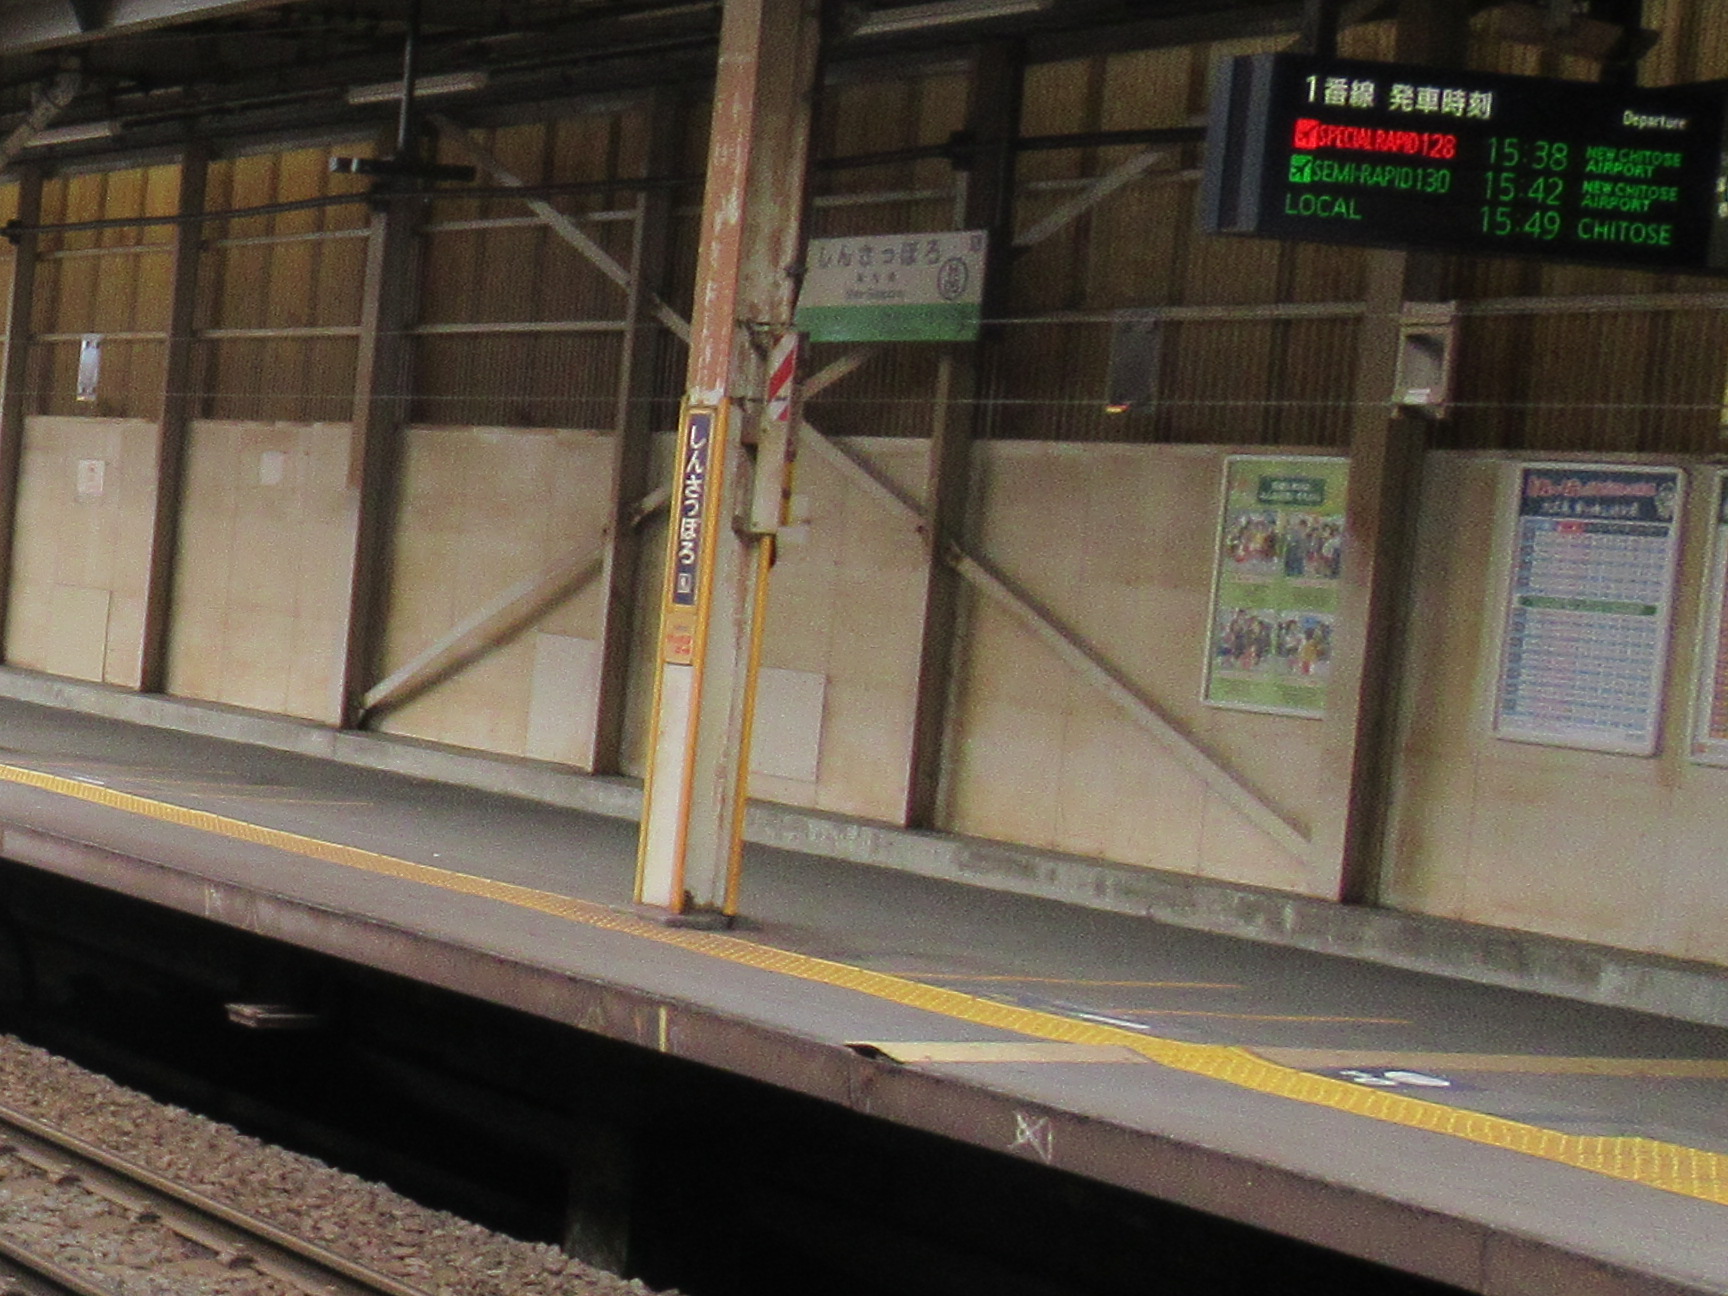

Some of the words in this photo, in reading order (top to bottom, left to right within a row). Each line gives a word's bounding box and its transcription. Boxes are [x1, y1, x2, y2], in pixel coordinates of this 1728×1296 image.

[1306, 75, 1375, 108] 1番線
[1388, 83, 1494, 120] 発車時刻
[1622, 109, 1688, 131] Departure
[1488, 136, 1569, 172] 15:38
[1585, 159, 1655, 179] AIRPORT
[1484, 170, 1565, 206] 15:42
[1581, 194, 1652, 213] AIRPORT
[1285, 193, 1363, 220] LOCAL
[1479, 205, 1561, 241] 15:49
[1577, 217, 1673, 246] CHITOSE
